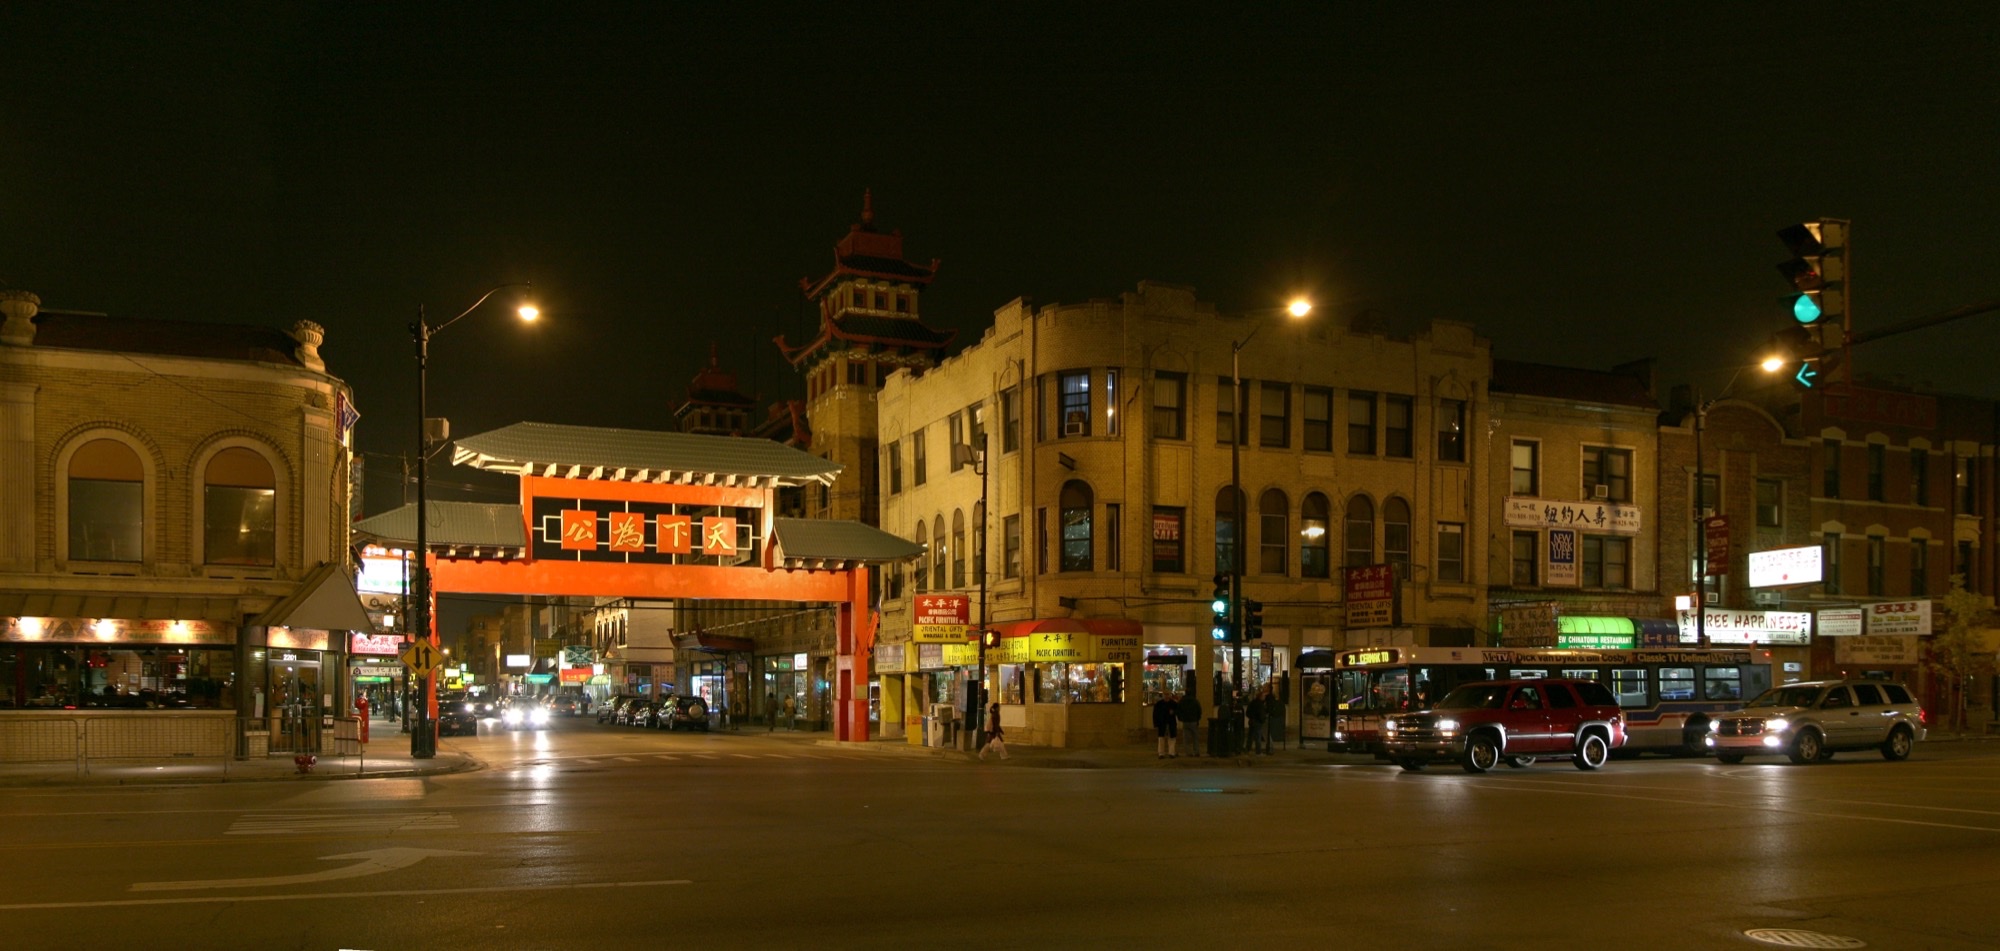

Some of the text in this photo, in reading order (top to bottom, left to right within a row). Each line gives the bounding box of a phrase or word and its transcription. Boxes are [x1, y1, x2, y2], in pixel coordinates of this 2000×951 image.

[1544, 504, 1607, 528] 紐約人壽
[1153, 529, 1179, 541] SALE
[1553, 533, 1572, 542] NEW
[1551, 541, 1573, 551] YORK
[1553, 550, 1571, 560] LIFE
[1350, 566, 1390, 580] 太平洋
[1348, 591, 1363, 600] PACIFIC
[1363, 589, 1384, 598] FURNITURE
[922, 598, 962, 609] 太平洋
[1376, 600, 1392, 608] GIFTS
[919, 616, 935, 624] PACIFIC
[935, 616, 959, 624] FURNITURE
[1690, 613, 1799, 630] TREE HAPPINESS
[1043, 633, 1074, 643] 太平洋
[1101, 638, 1137, 646] FURNITURE
[1558, 635, 1567, 644] EW
[1568, 635, 1599, 644] CHINATOWN
[1600, 635, 1632, 644] RESTAURANT
[283, 653, 297, 661] 2201
[1036, 649, 1051, 657] PACIFIC
[1052, 648, 1075, 657] FURNITURE
[1108, 652, 1131, 660] GIFTS
[1483, 652, 1508, 662] MeTV
[1637, 653, 1710, 662] Classic TV Defined
[1348, 654, 1355, 665] 21
[1381, 651, 1389, 662] TO
[1516, 653, 1536, 662] Dick
[1538, 654, 1554, 662] Van
[1556, 654, 1577, 664] Dyke
[1586, 654, 1600, 662] Bill
[1601, 654, 1628, 664] Cosby
